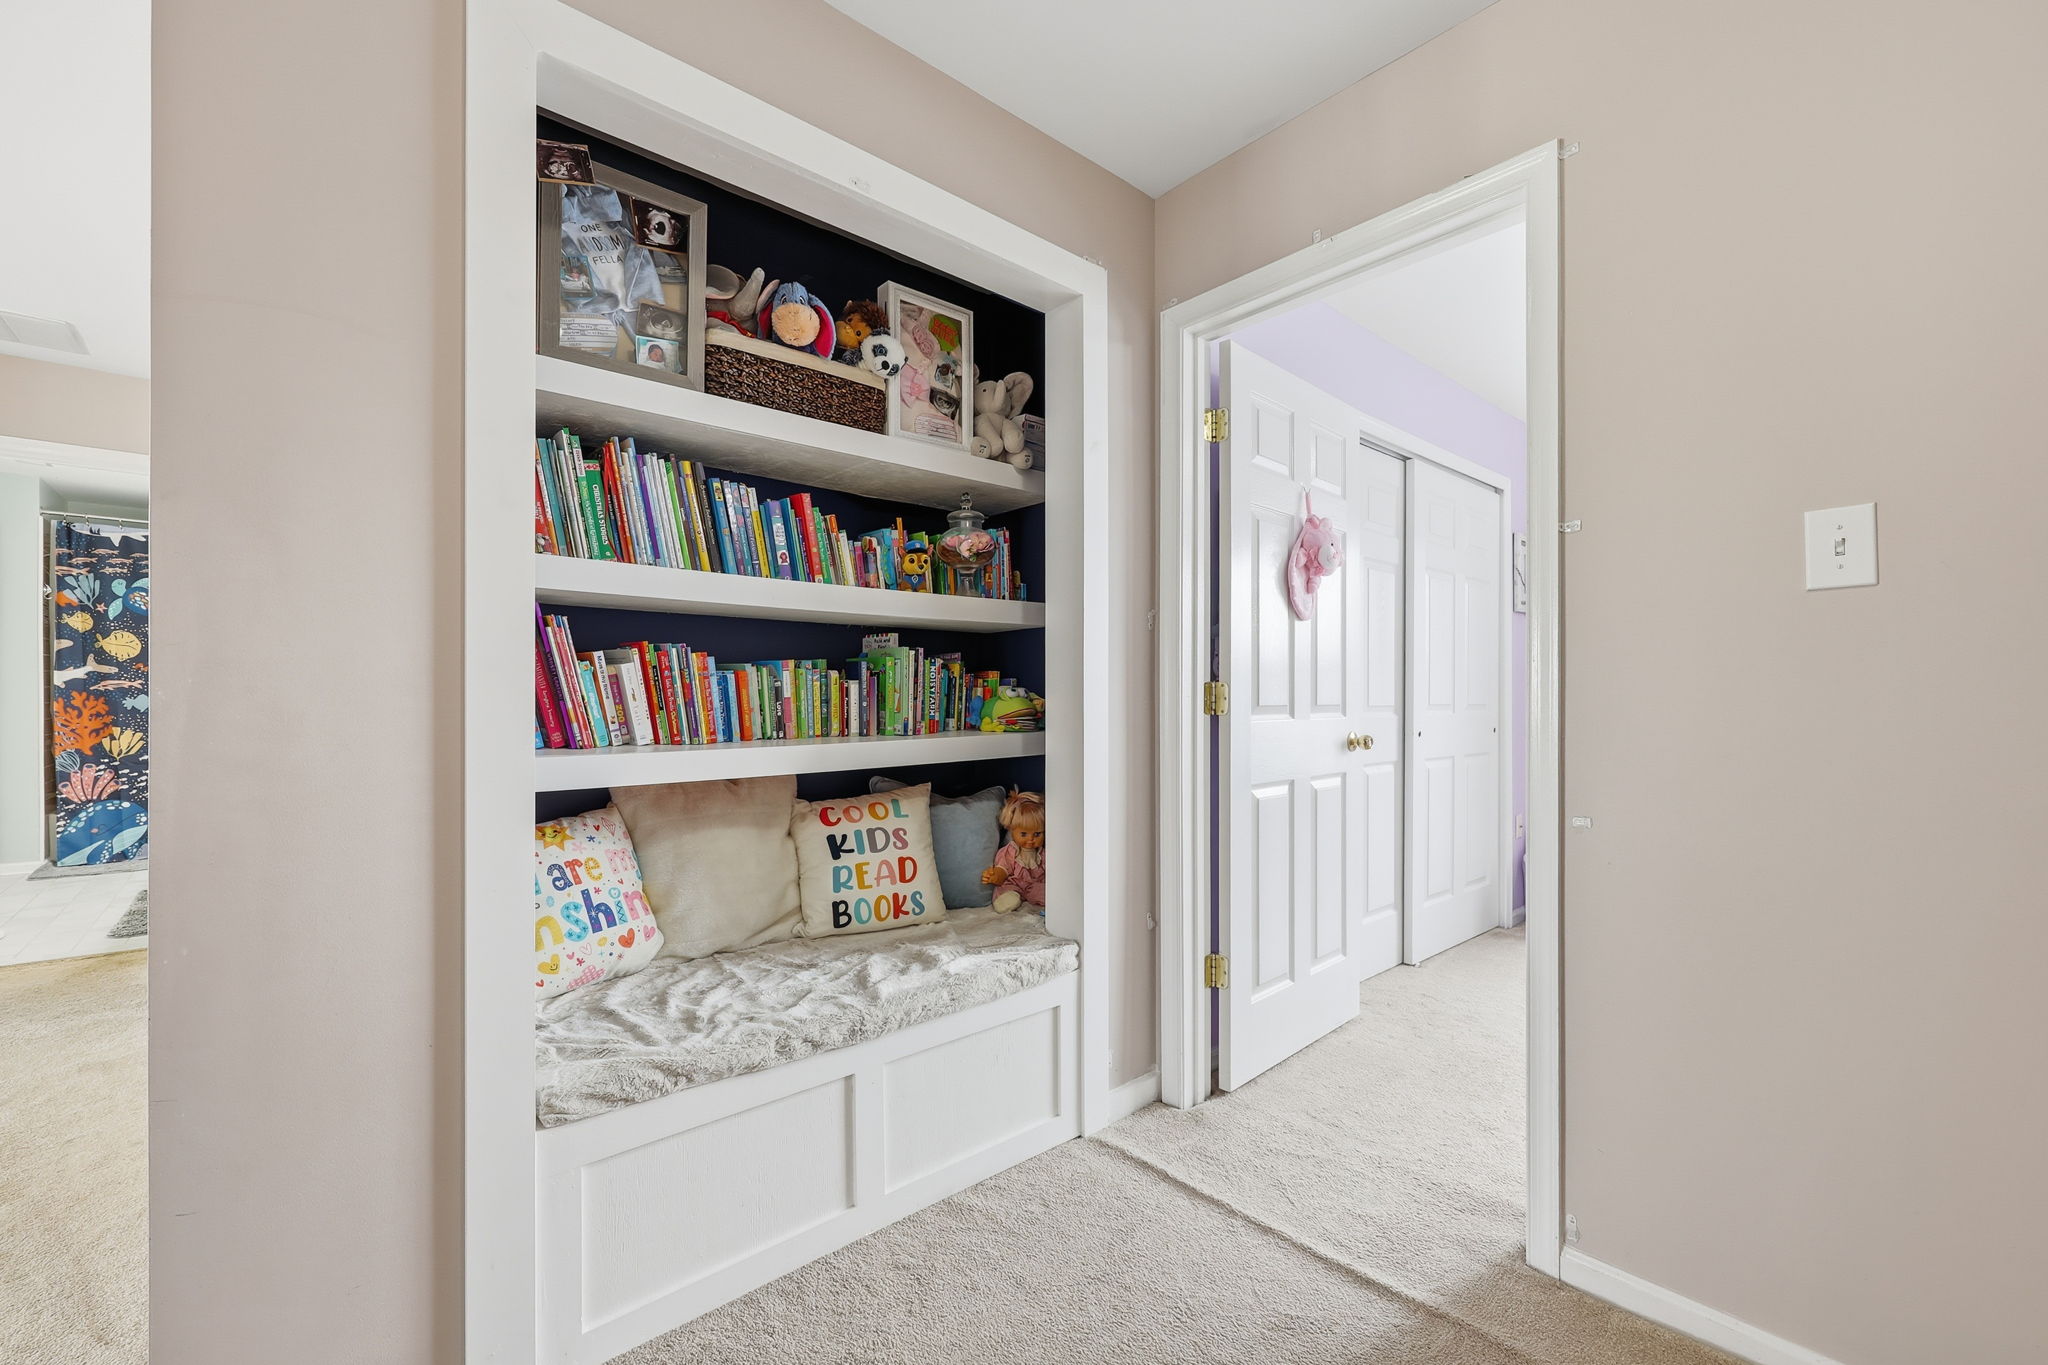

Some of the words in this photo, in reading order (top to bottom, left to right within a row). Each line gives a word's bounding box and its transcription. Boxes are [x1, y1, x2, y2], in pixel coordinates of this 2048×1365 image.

[580, 223, 602, 233] ONE
[592, 255, 624, 265] FELLA
[616, 704, 625, 723] ZOO
[818, 798, 910, 827] COOL
[826, 826, 909, 861] KIDS
[546, 857, 603, 892] are
[831, 856, 918, 894] READ
[535, 878, 651, 952] nshin
[831, 890, 926, 929] BOOKS
